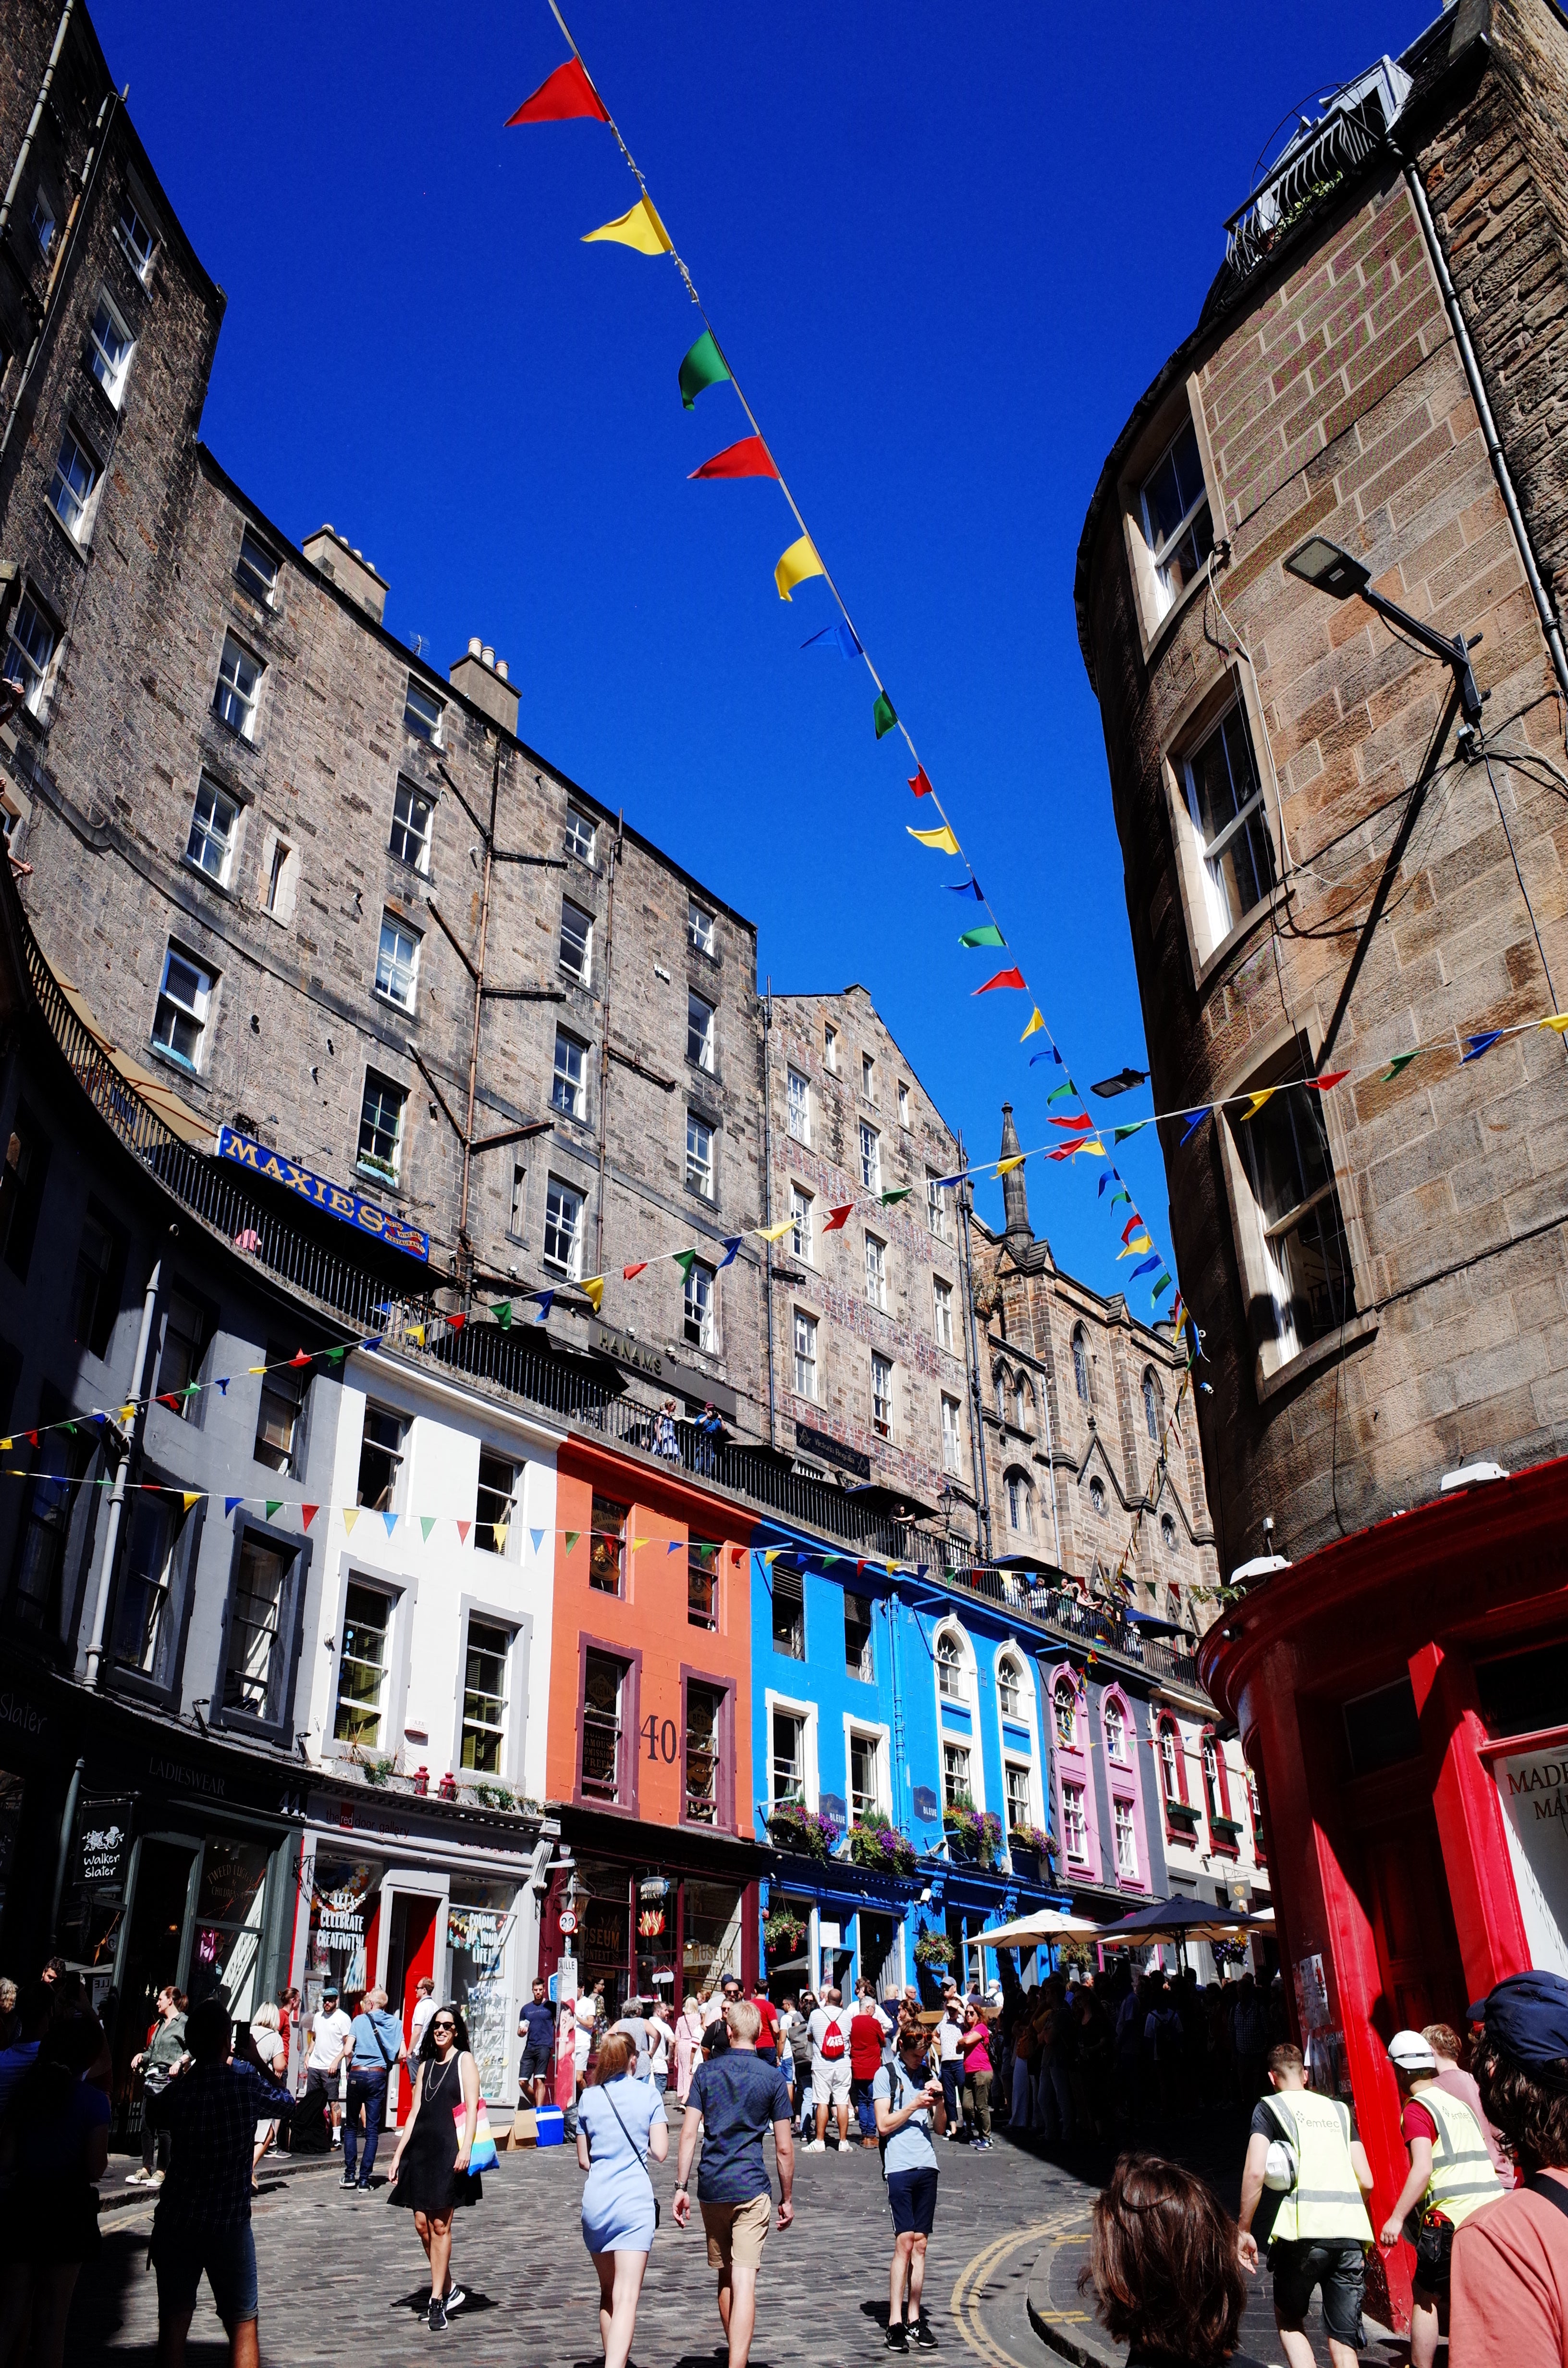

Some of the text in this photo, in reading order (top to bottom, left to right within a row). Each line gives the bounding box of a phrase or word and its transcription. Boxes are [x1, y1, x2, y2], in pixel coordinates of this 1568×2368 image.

[226, 1135, 383, 1232] MAXIES
[386, 1220, 402, 1230] BISTRO
[412, 1231, 422, 1240] BAR
[600, 1329, 662, 1376] HANAMS
[814, 1437, 855, 1464] Victoria Regalia
[693, 1714, 708, 1726] BEST
[584, 1738, 610, 1749] AMOUS
[641, 1715, 677, 1764] 40
[584, 1747, 614, 1761] DMISSION
[149, 1757, 224, 1796] LADIESWEAR
[922, 1806, 937, 1817] BLEUE
[1533, 1795, 1568, 1820] MA
[327, 1808, 409, 1839] the red door gallery
[829, 1812, 846, 1824] BLEUE
[207, 1864, 231, 1885] TWEED
[320, 1910, 364, 1932] CELEBRATE
[469, 1912, 497, 1932] COLOUR
[561, 1917, 575, 1927] 20
[480, 1929, 499, 1947] YOUR
[585, 1927, 619, 1953] USEUM
[473, 1947, 491, 1964] LIFE!
[585, 1949, 610, 1961] ONTEXT
[692, 1945, 734, 1969] MUSEUM
[1306, 2119, 1339, 2128] emtec
